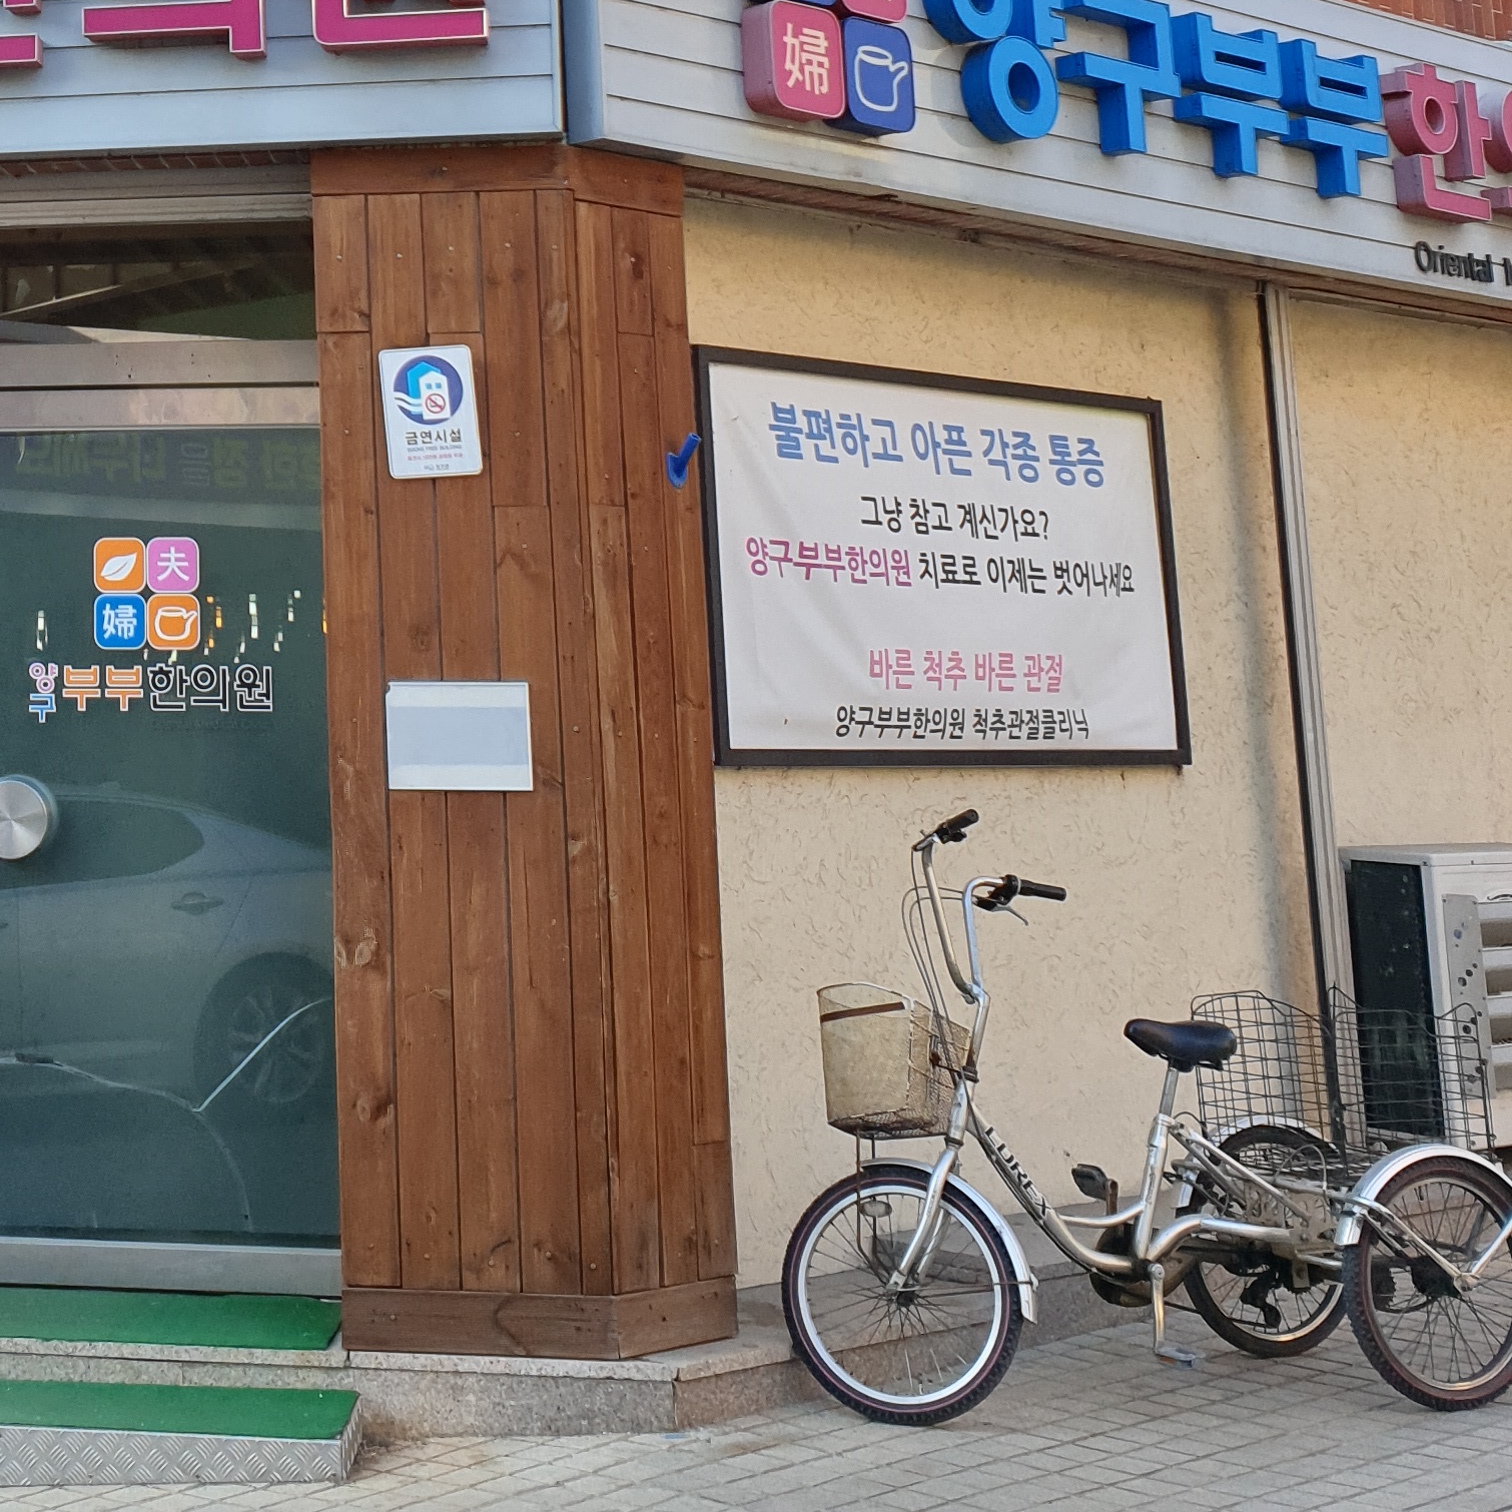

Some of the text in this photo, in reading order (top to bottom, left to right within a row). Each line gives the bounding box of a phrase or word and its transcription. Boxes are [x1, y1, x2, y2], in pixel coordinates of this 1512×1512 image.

[782, 21, 830, 96] 婦
[1414, 240, 1494, 284] Oriental
[405, 428, 462, 446] 금연시설
[767, 400, 1106, 488] 불편하고 아픈 각종 통증
[859, 495, 1050, 543] 그냥 참고 계신가요?
[156, 545, 190, 582] 夫
[744, 536, 1136, 598] 양구부부한의원 치료로 이제는 벗어나세요
[101, 602, 138, 640] 婦
[867, 648, 1065, 694] 바른 척추 바른 관절
[834, 704, 1090, 741] 양구부부한의원 척추관절클리닉
[984, 1125, 1052, 1220] LUREX
